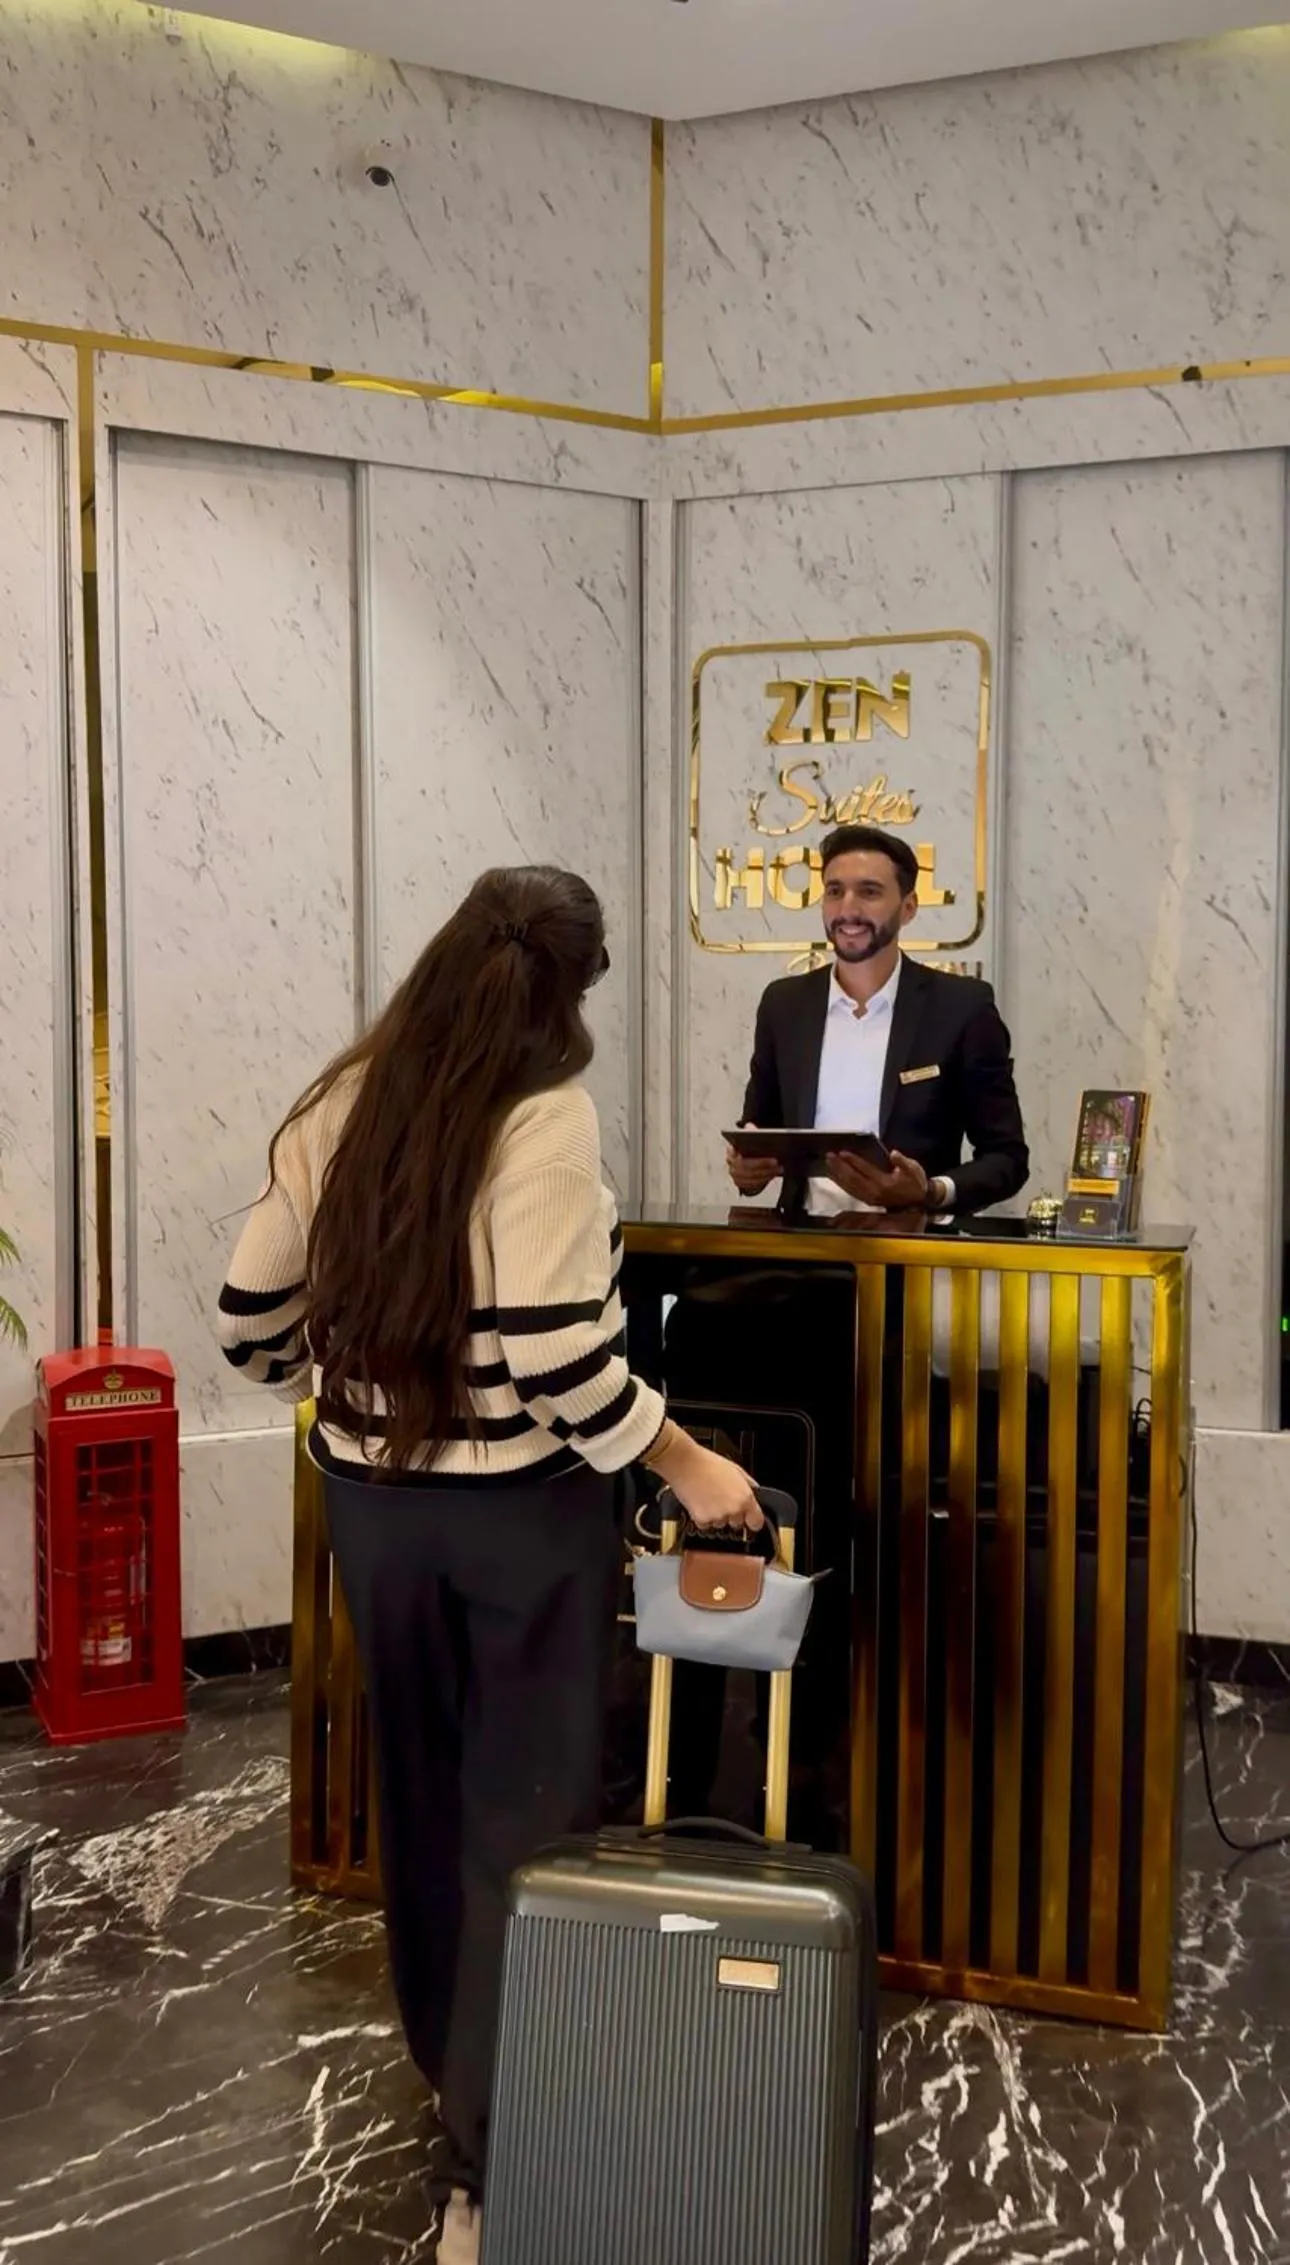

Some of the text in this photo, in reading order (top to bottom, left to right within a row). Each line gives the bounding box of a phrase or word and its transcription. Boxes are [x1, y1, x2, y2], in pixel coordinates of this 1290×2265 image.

[763, 669, 912, 745] ZEN
[749, 760, 922, 836] Suites
[713, 842, 956, 911] HOL
[71, 1391, 157, 1408] TELEPHONE
